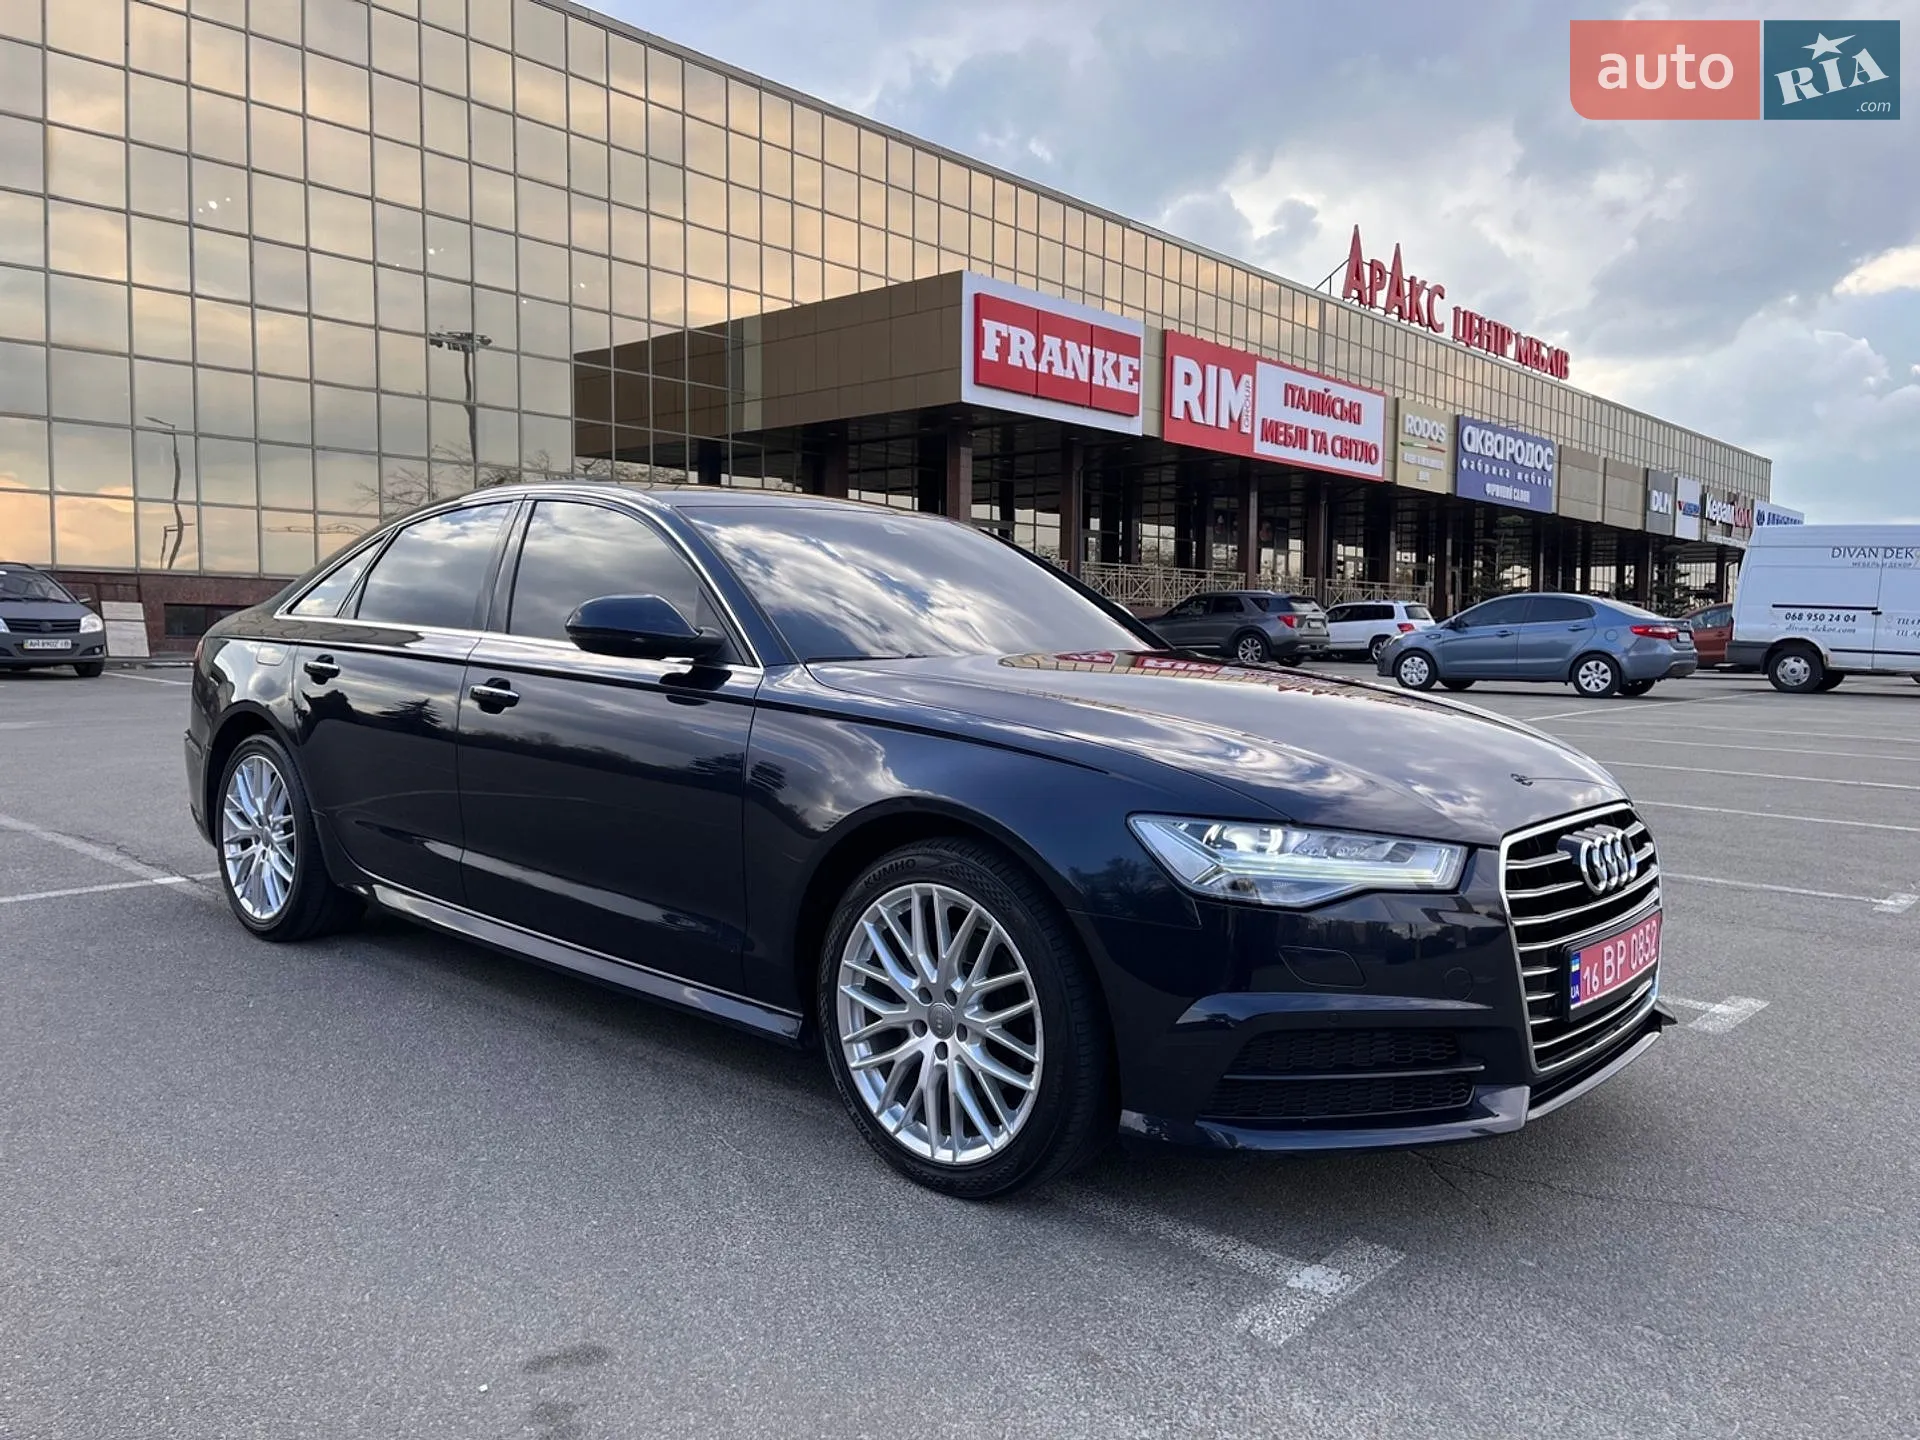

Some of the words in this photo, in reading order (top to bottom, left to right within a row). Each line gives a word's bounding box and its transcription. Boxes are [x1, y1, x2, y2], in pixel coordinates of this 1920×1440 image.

[982, 318, 1140, 394] FRANKE
[1452, 305, 1513, 359] ЦЕНТР
[1514, 331, 1571, 380] МЕБЛІВ
[1170, 355, 1253, 434] RIM
[1243, 379, 1254, 430] GROUP
[1284, 382, 1363, 425] ІТАЛІЙСЬКІ
[1260, 418, 1309, 451] МЕБЛІ
[1311, 428, 1329, 456] ТА
[1331, 433, 1379, 465] СВІТЛО
[1404, 413, 1446, 442] RODOS
[1831, 546, 1879, 559] DIVAN
[1785, 611, 1804, 621] 068
[1807, 612, 1825, 622] 950
[1829, 613, 1841, 623] 24
[1843, 614, 1857, 623] 04
[863, 857, 916, 889] KUMHO
[1583, 962, 1599, 996] 16
[1603, 939, 1627, 986] BP
[1630, 919, 1657, 970] 0852
[1570, 985, 1580, 999] UA
